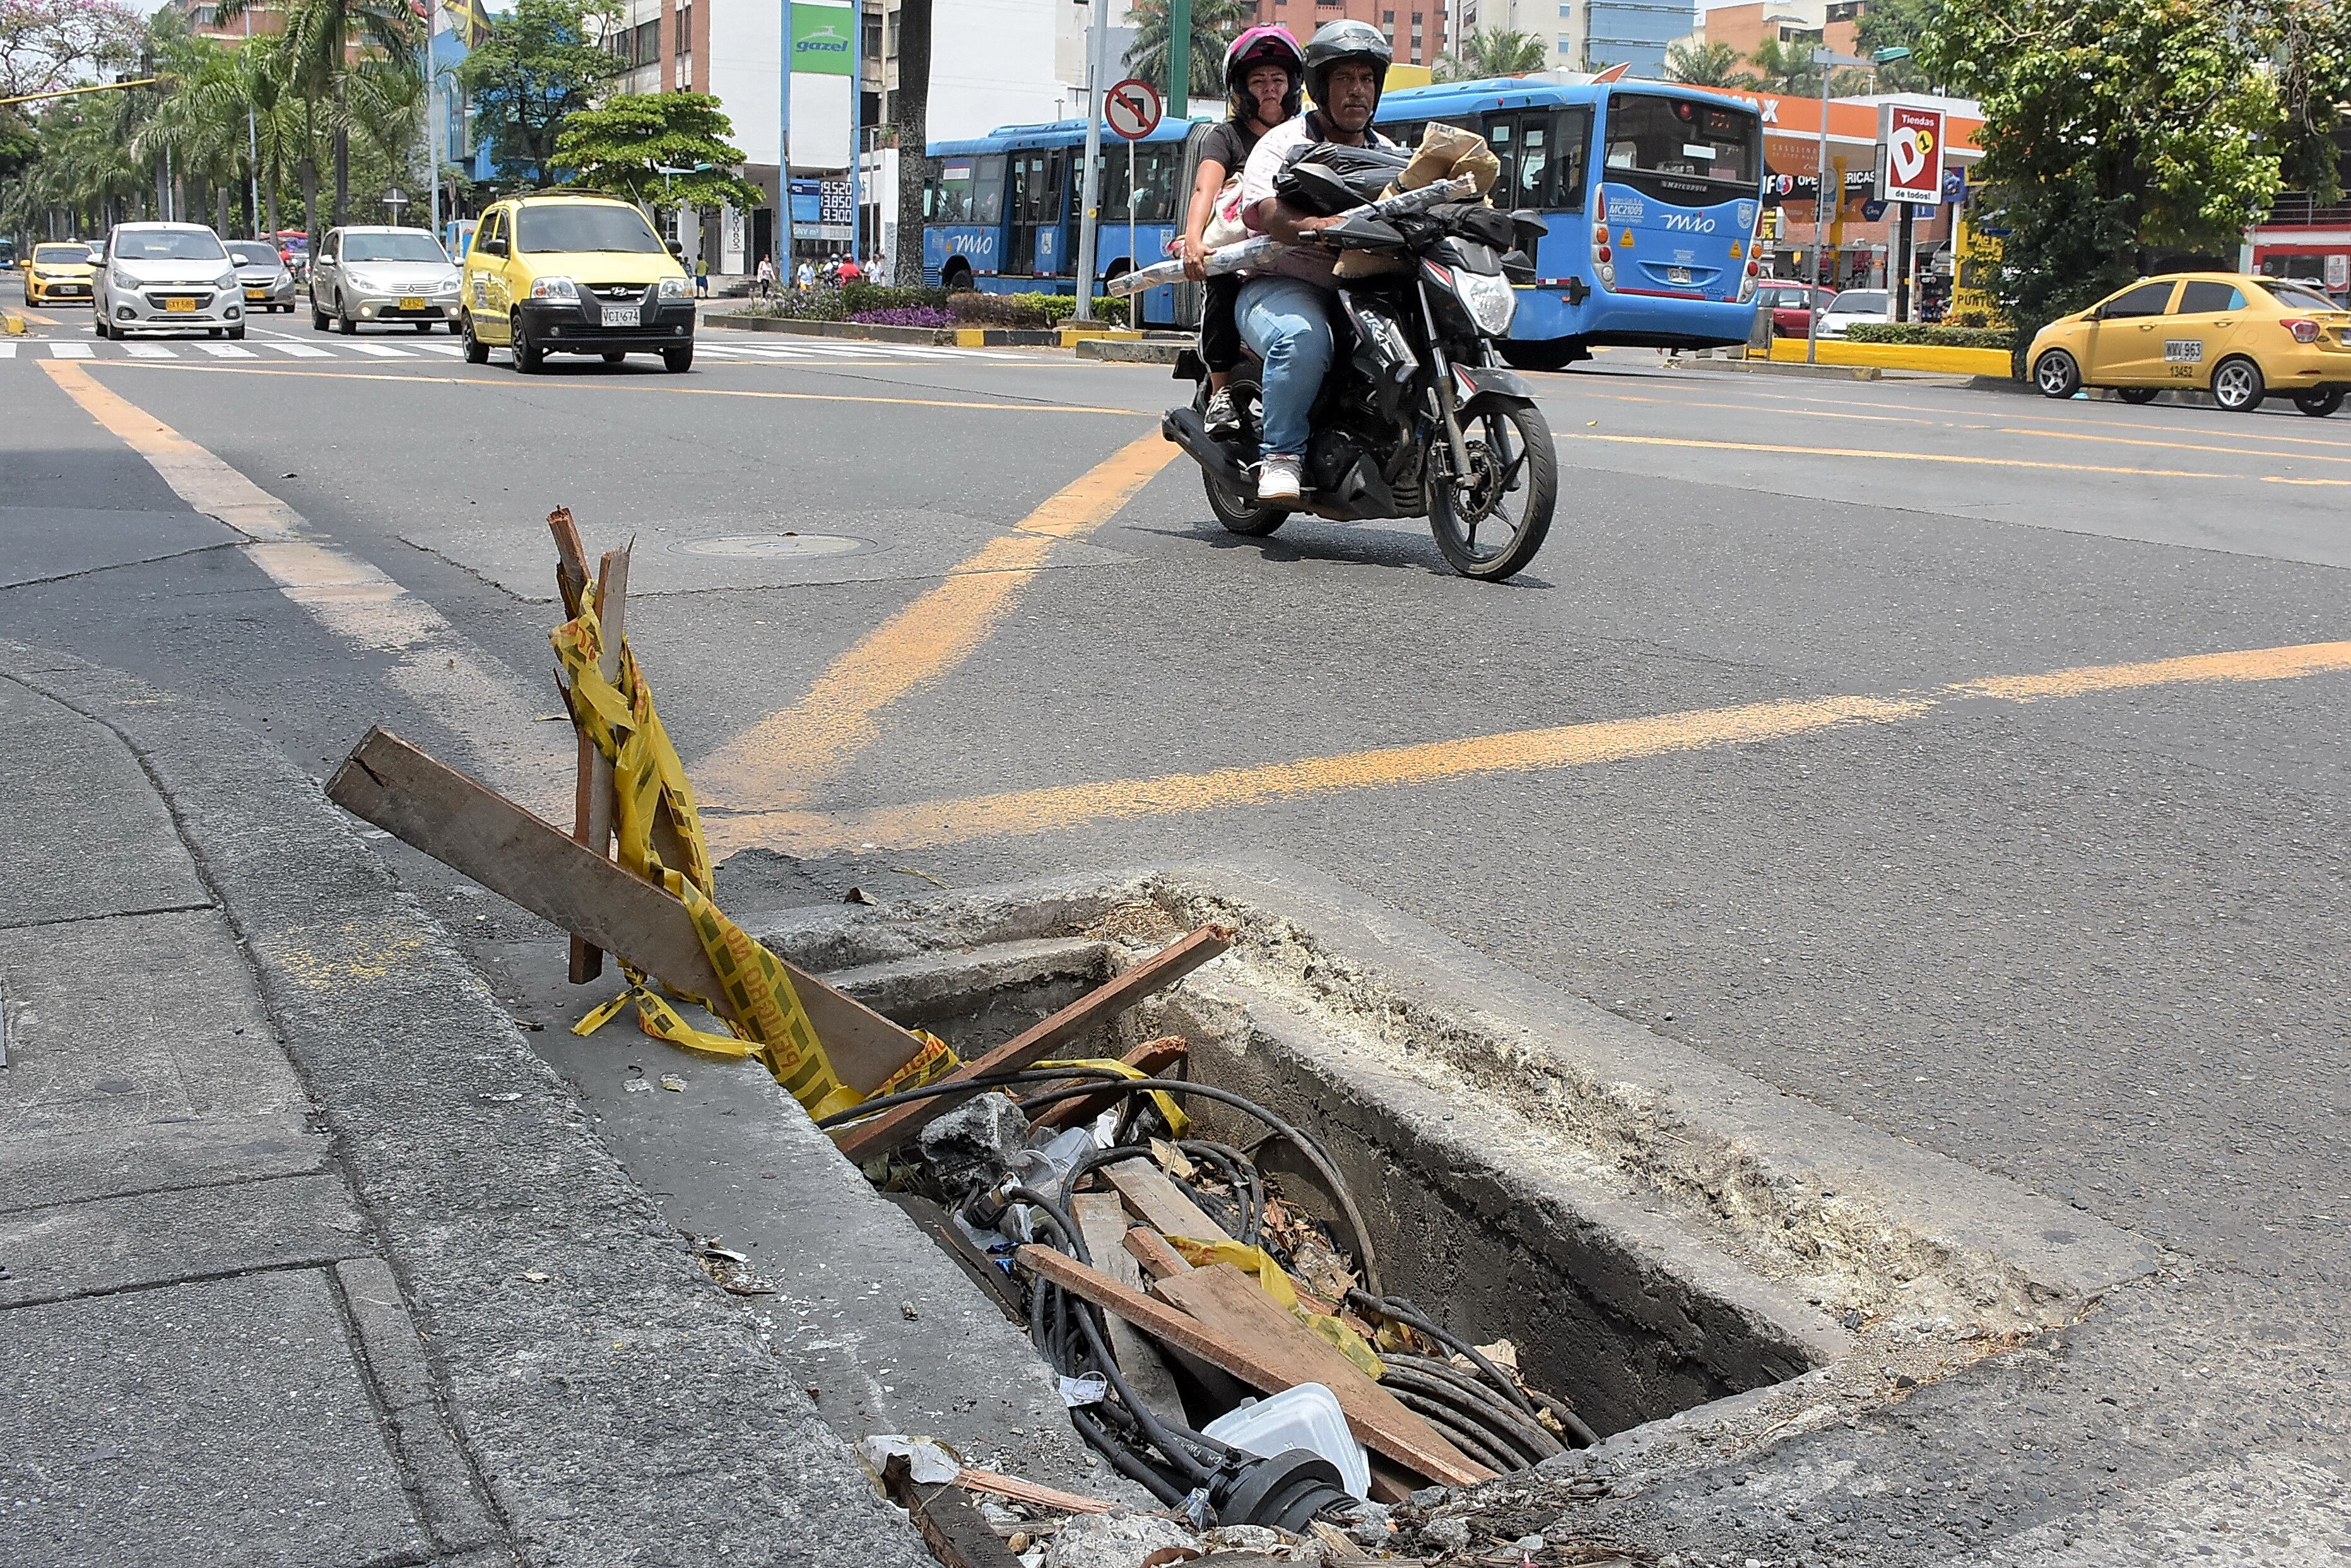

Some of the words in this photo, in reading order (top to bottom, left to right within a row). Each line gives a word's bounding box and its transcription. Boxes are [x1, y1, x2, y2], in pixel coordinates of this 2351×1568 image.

[796, 40, 848, 52] gazel
[1901, 114, 1935, 127] Tiendas
[820, 181, 852, 195] 19.520
[1895, 189, 1905, 198] de
[1907, 191, 1931, 200] todos!
[820, 195, 852, 209] 13.850
[823, 208, 852, 222] 9.300
[1609, 204, 1643, 215] MC21009
[622, 311, 639, 322] 674
[2184, 343, 2201, 357] 963
[2170, 365, 2193, 377] 13452
